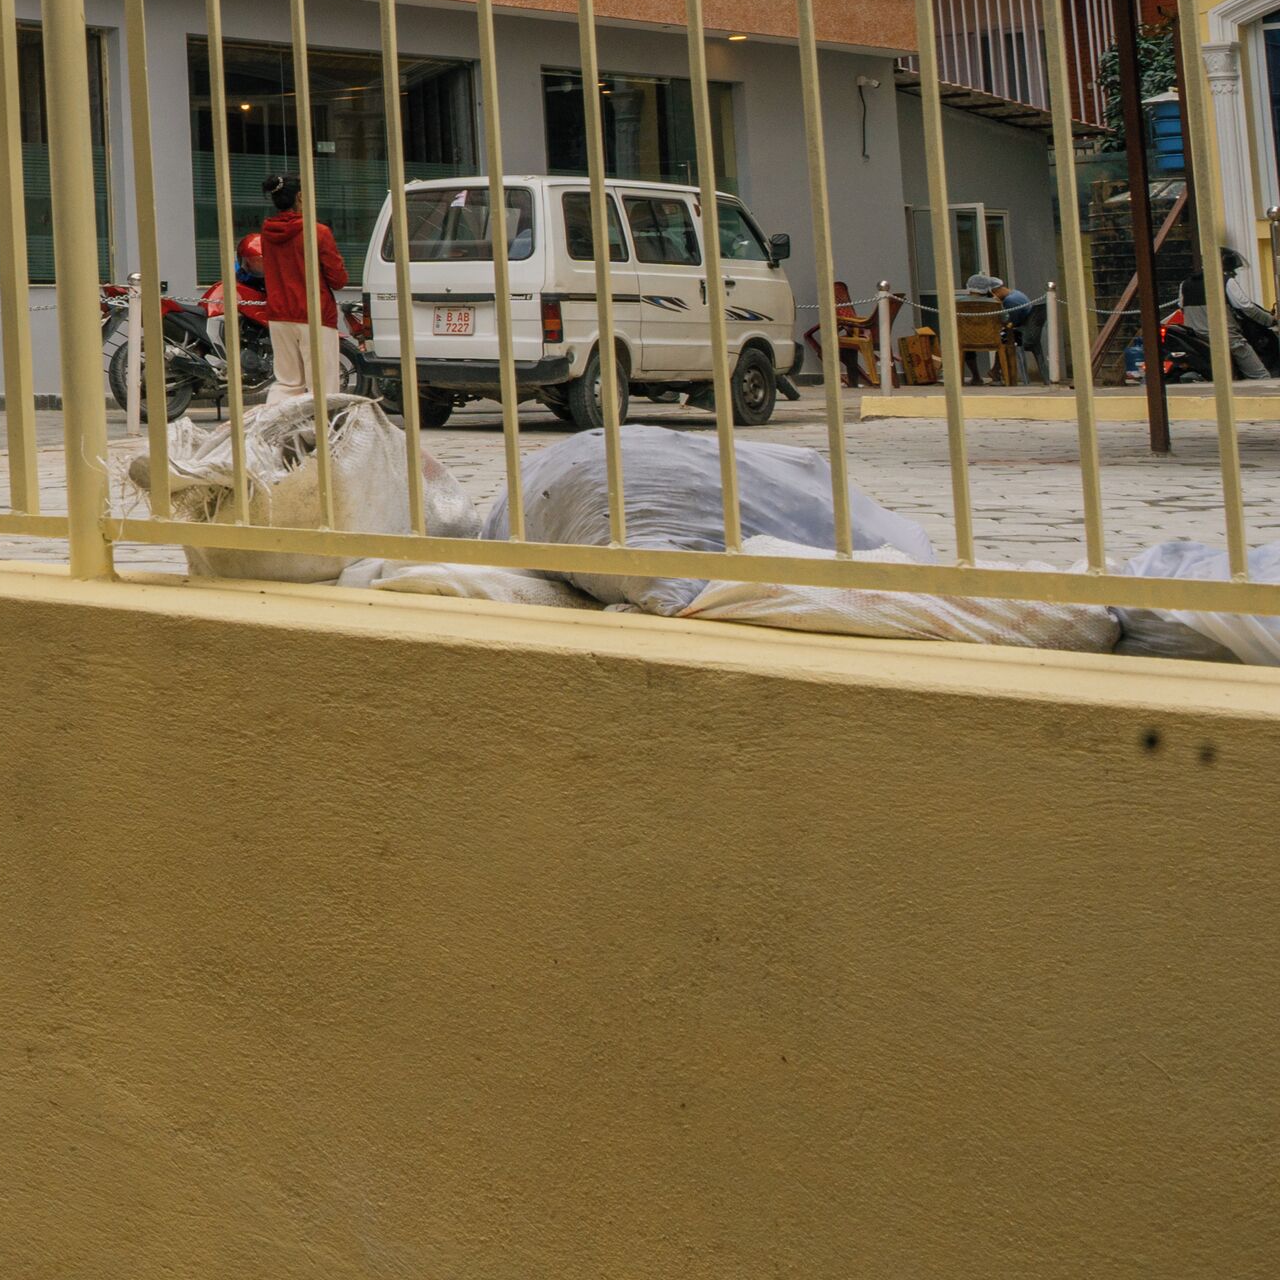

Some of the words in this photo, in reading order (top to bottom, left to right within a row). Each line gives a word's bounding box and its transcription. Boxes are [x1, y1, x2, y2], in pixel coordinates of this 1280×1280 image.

[446, 312, 453, 322] B
[457, 312, 470, 322] AB
[446, 323, 470, 332] 7227
